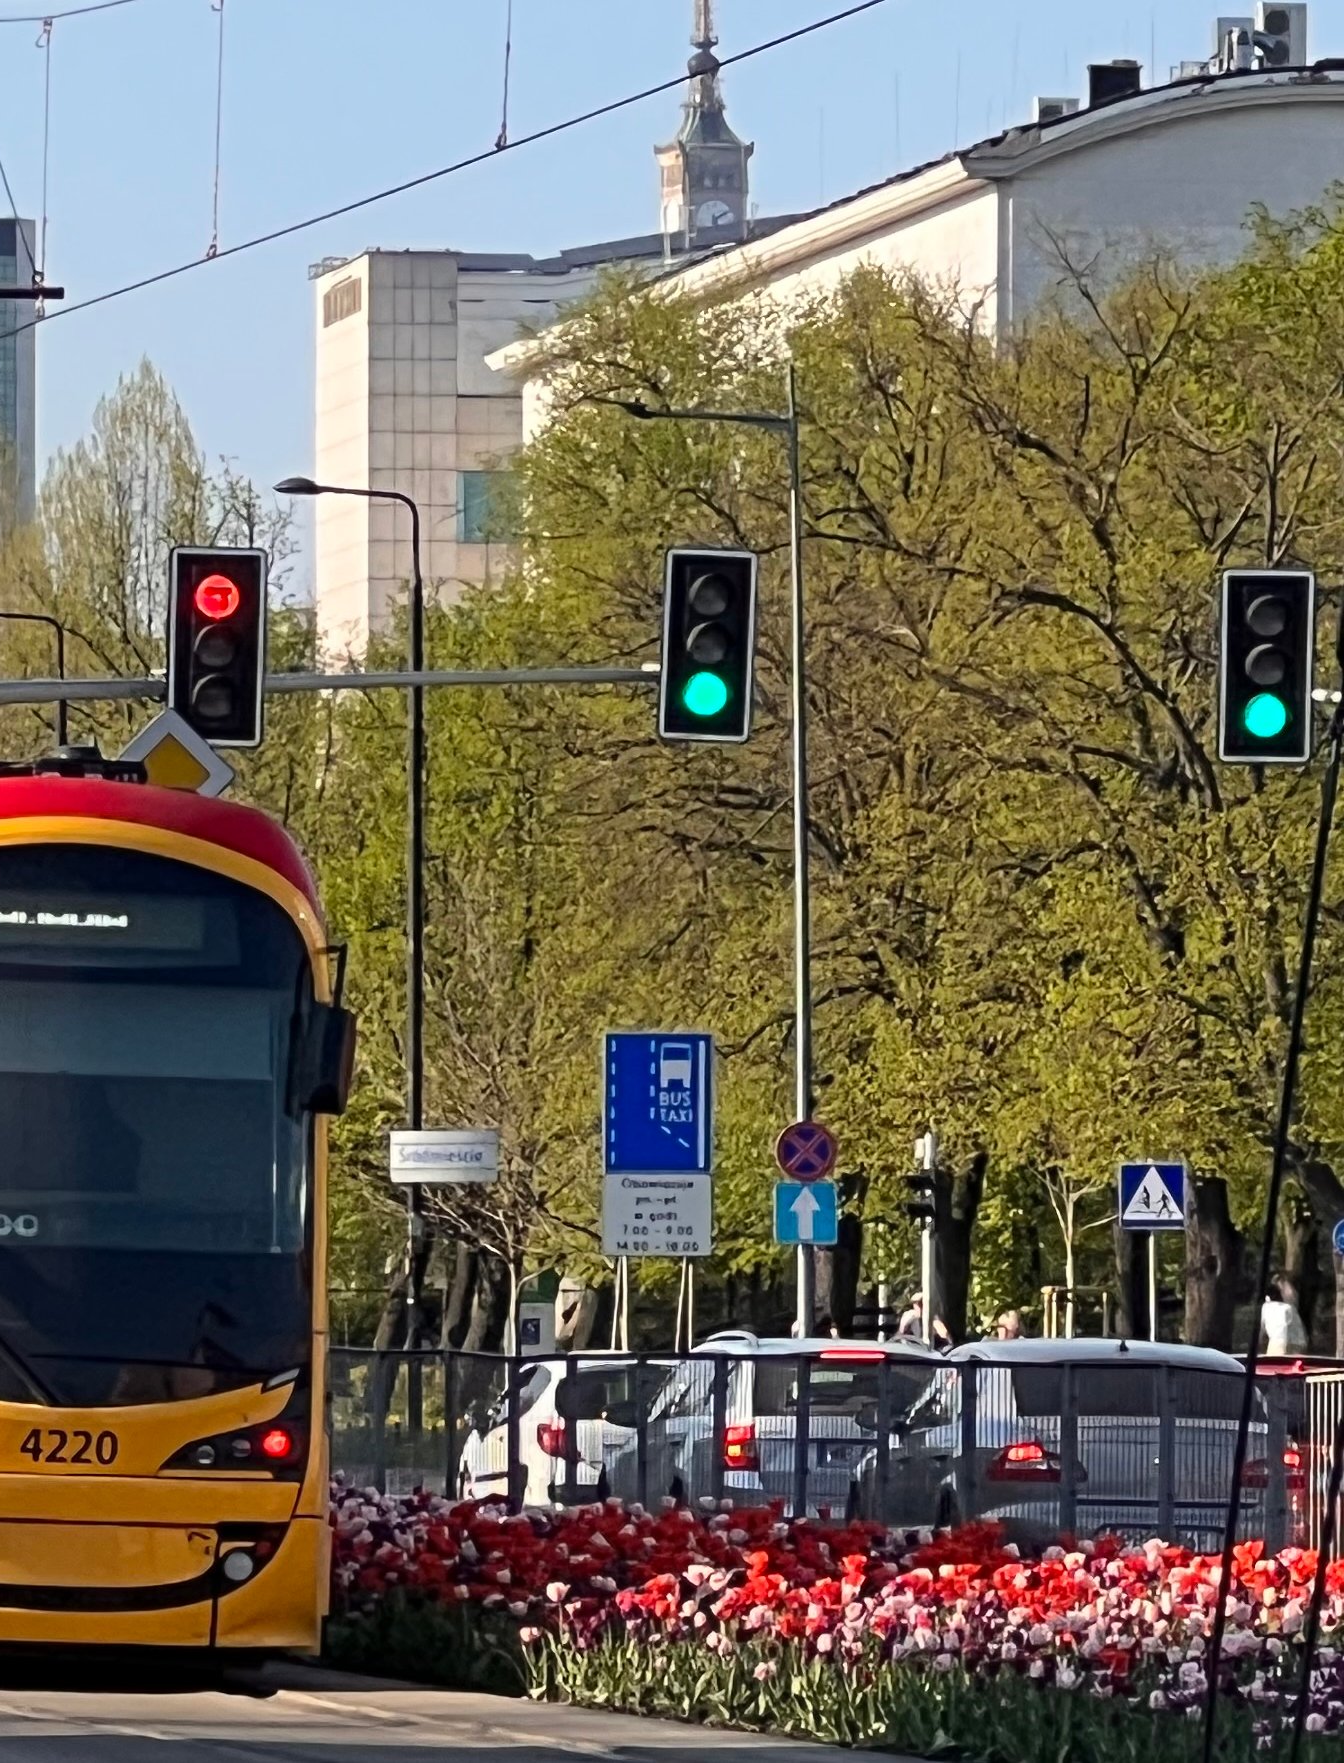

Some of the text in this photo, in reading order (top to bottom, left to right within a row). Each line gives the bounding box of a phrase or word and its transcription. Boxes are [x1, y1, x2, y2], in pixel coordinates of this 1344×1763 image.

[659, 1091, 691, 1106] BUS
[660, 1108, 692, 1122] TAXI
[20, 1428, 119, 1466] 4220
